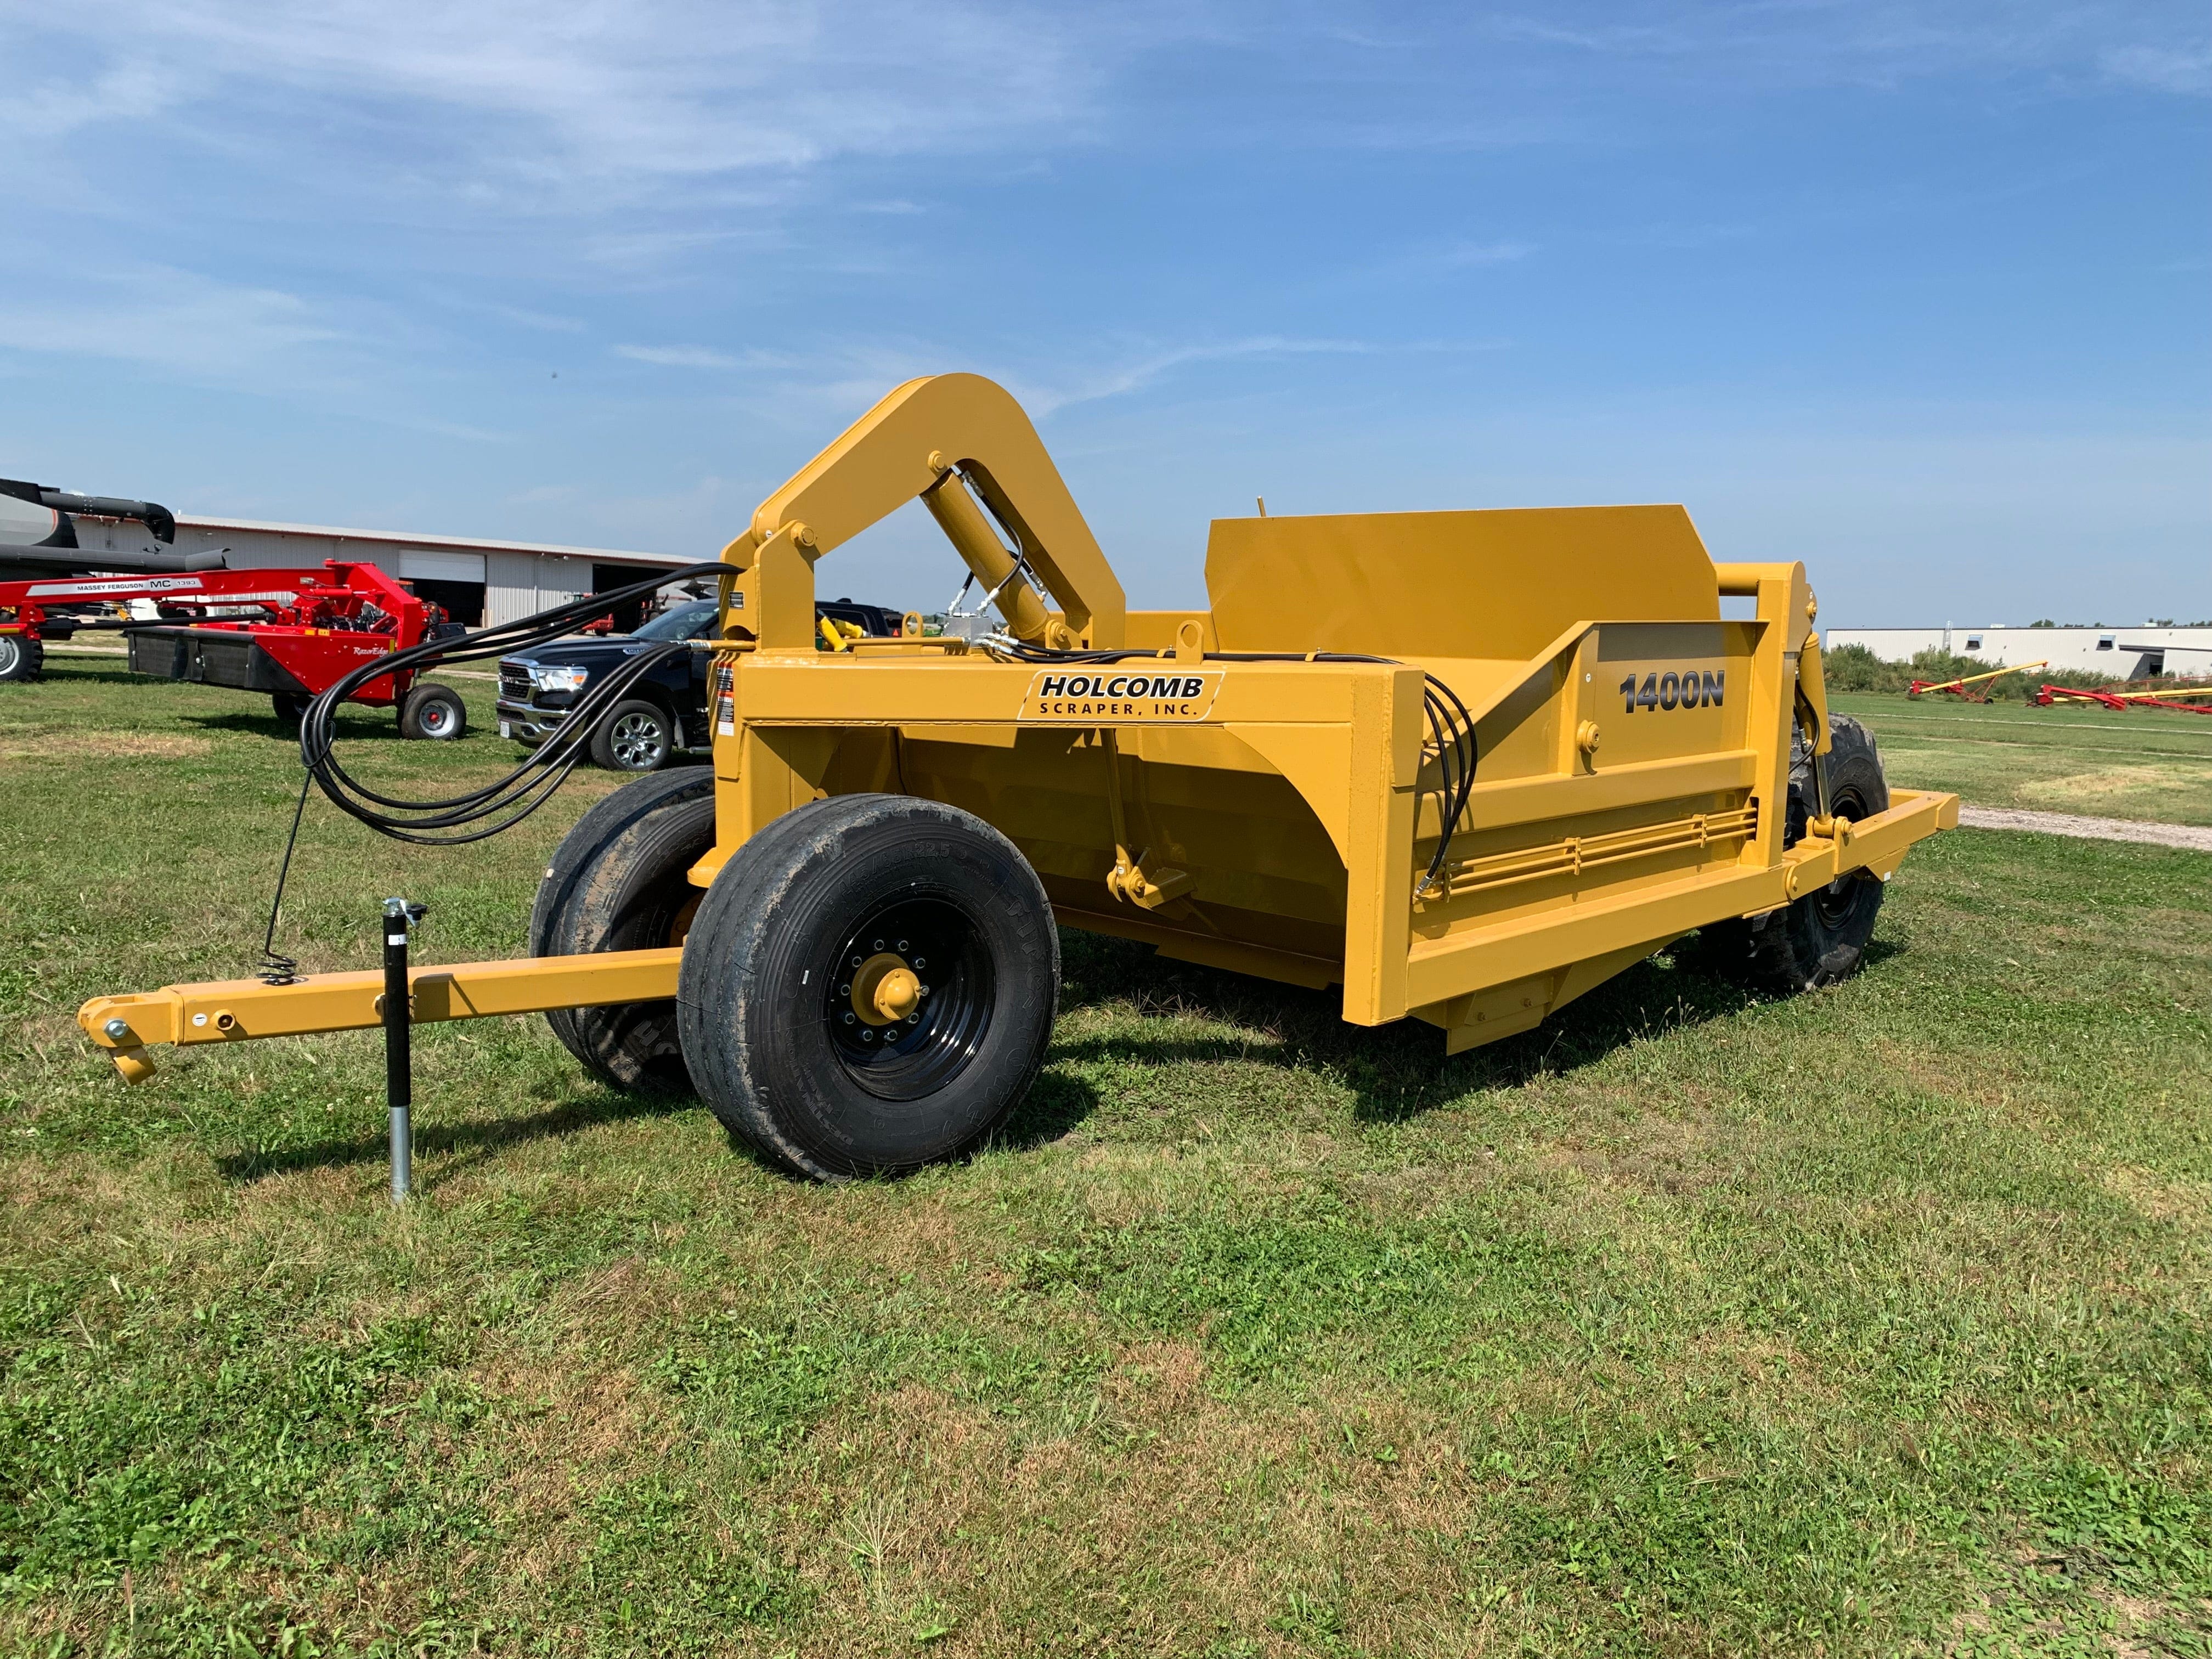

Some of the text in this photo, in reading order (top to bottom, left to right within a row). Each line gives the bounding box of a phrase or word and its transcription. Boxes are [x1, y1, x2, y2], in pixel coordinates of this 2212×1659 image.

[150, 580, 171, 588] MC
[1039, 676, 1204, 698] HOLCOMB
[1620, 670, 1725, 714] 1400N
[1040, 703, 1197, 716] SCRAPER, INC.
